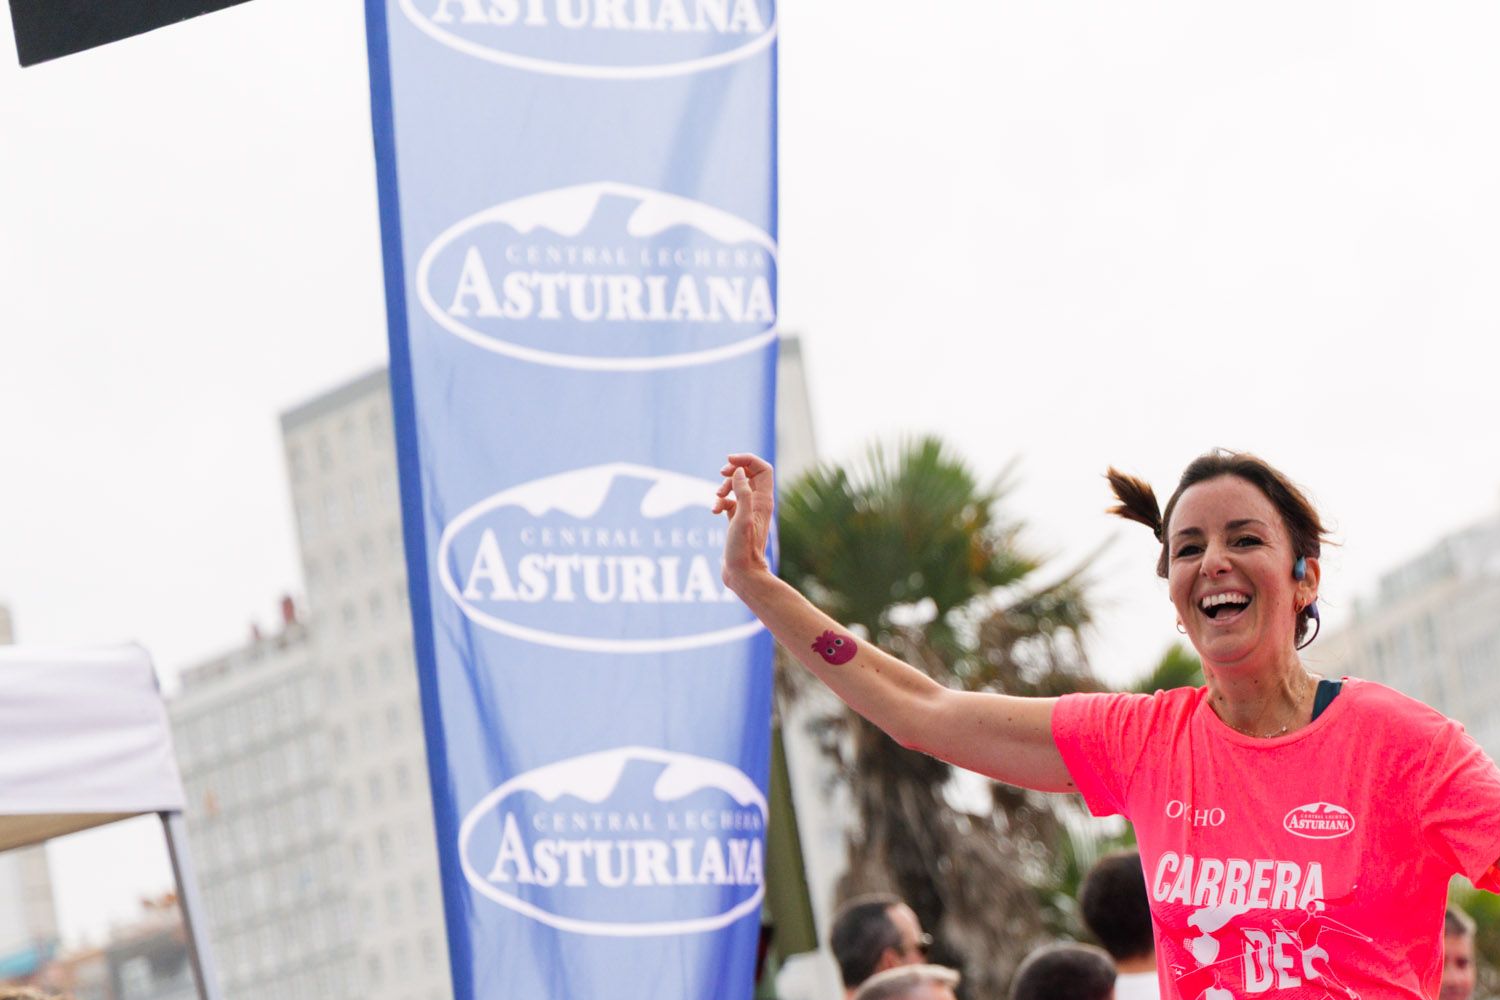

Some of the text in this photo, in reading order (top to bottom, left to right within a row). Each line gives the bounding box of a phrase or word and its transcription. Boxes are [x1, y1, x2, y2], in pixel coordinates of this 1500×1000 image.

[446, 246, 776, 323] ASTURIANA
[505, 244, 765, 269] CENTRAL LECHERA
[461, 526, 739, 602] ASTURIA
[519, 526, 726, 548] CENTRAL LECH
[487, 811, 764, 888] ASTURIANA
[533, 810, 656, 832] CENTRAL
[1288, 814, 1350, 831] ASTURIANA
[1153, 850, 1326, 912] CARRERA
[1241, 927, 1302, 994] DE
